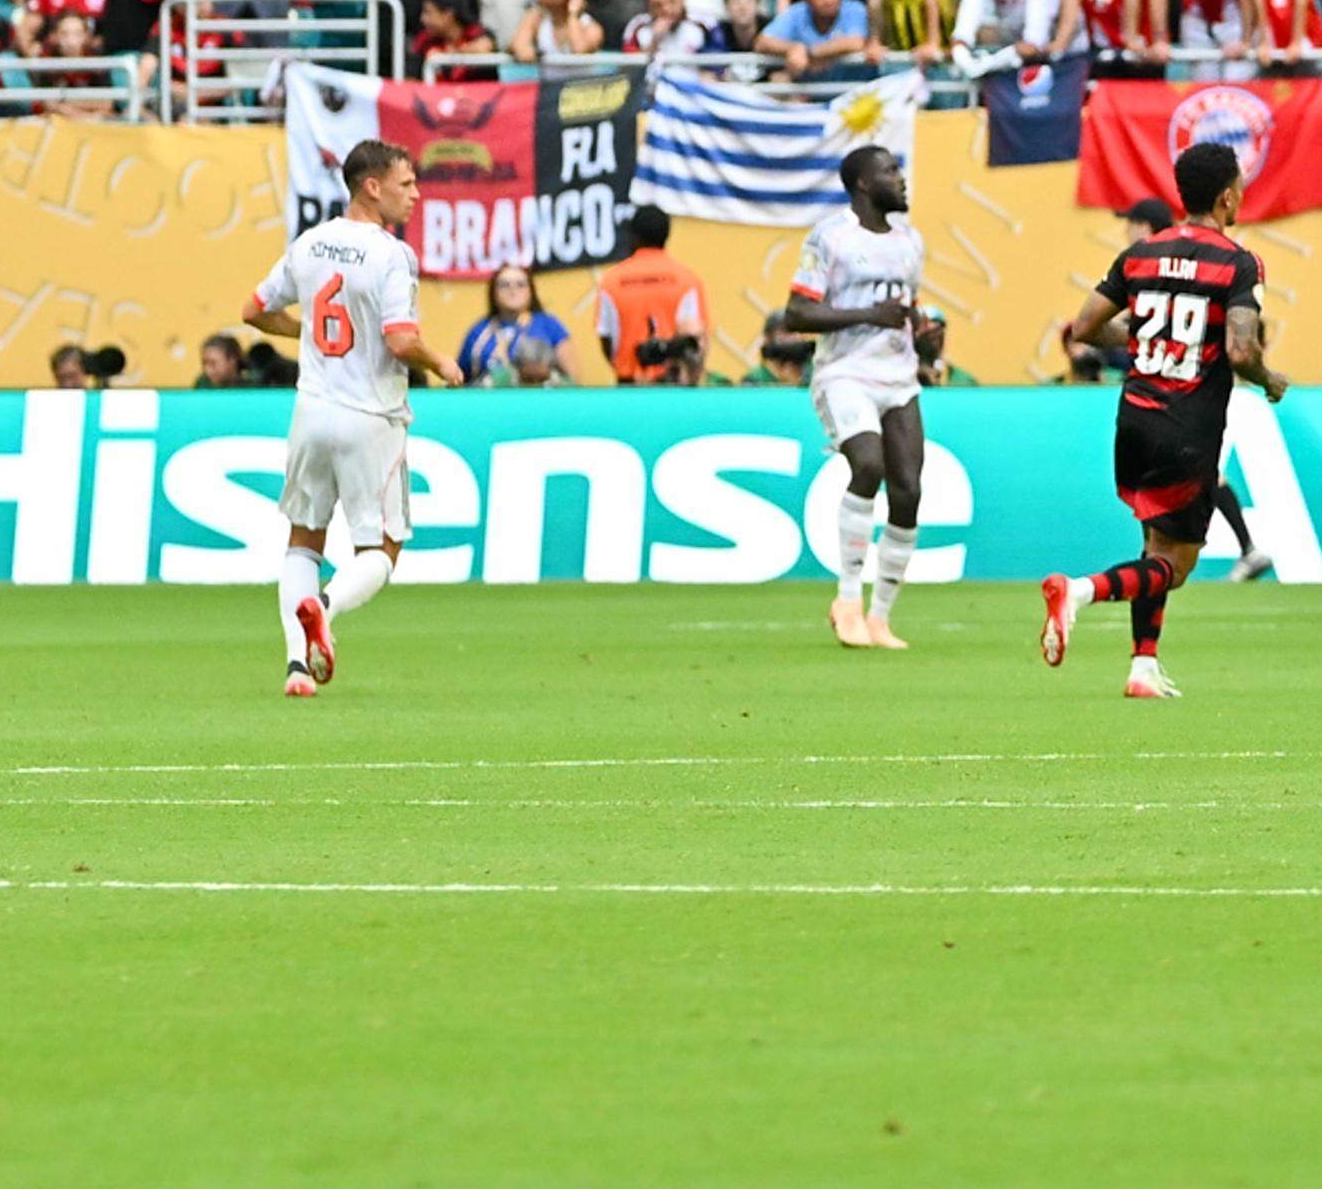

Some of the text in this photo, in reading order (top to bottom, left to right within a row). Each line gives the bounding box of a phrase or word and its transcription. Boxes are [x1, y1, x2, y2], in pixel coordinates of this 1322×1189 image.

[560, 121, 619, 183] FLA
[313, 271, 355, 358] 6
[1134, 289, 1211, 382] 29
